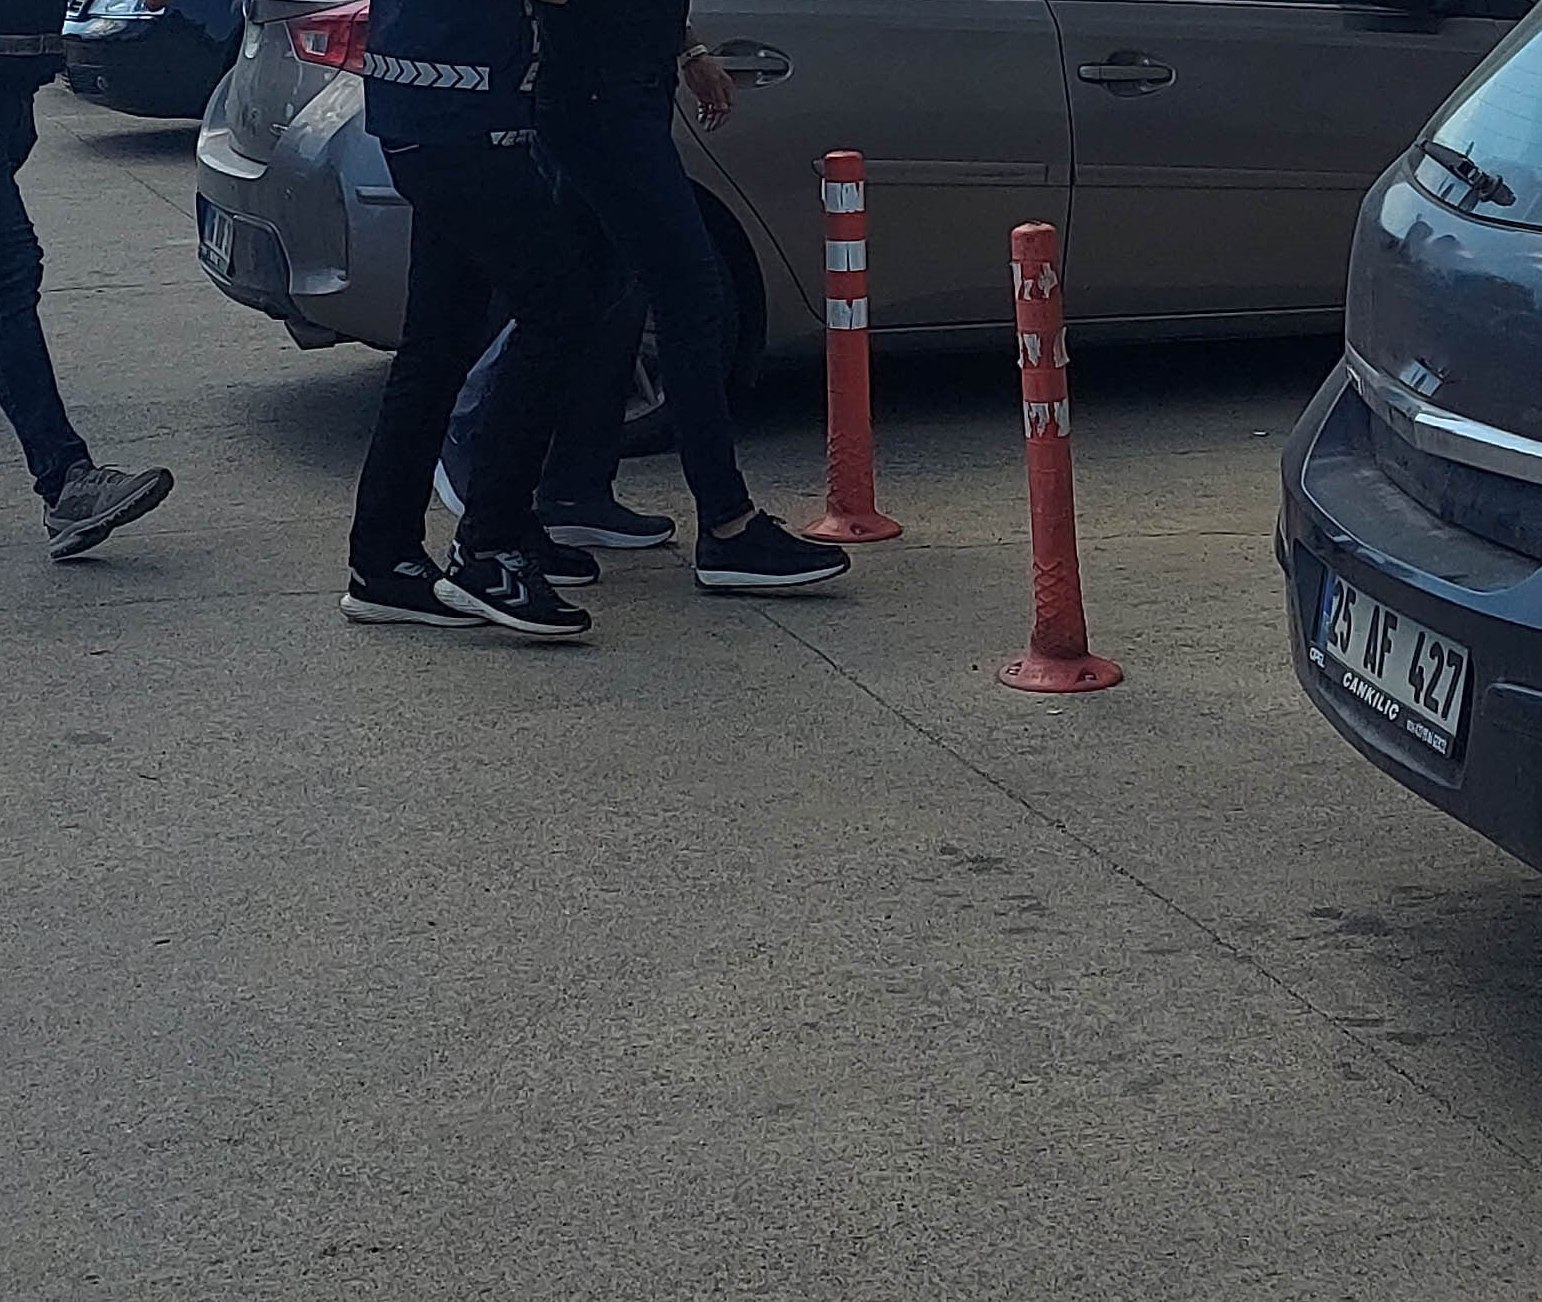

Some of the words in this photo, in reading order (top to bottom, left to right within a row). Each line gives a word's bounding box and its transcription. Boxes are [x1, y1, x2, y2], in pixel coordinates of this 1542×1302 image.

[1328, 580, 1357, 653] 25
[1363, 605, 1398, 678] AF
[1408, 631, 1464, 721] 427
[1342, 672, 1400, 721] CANKILIC
